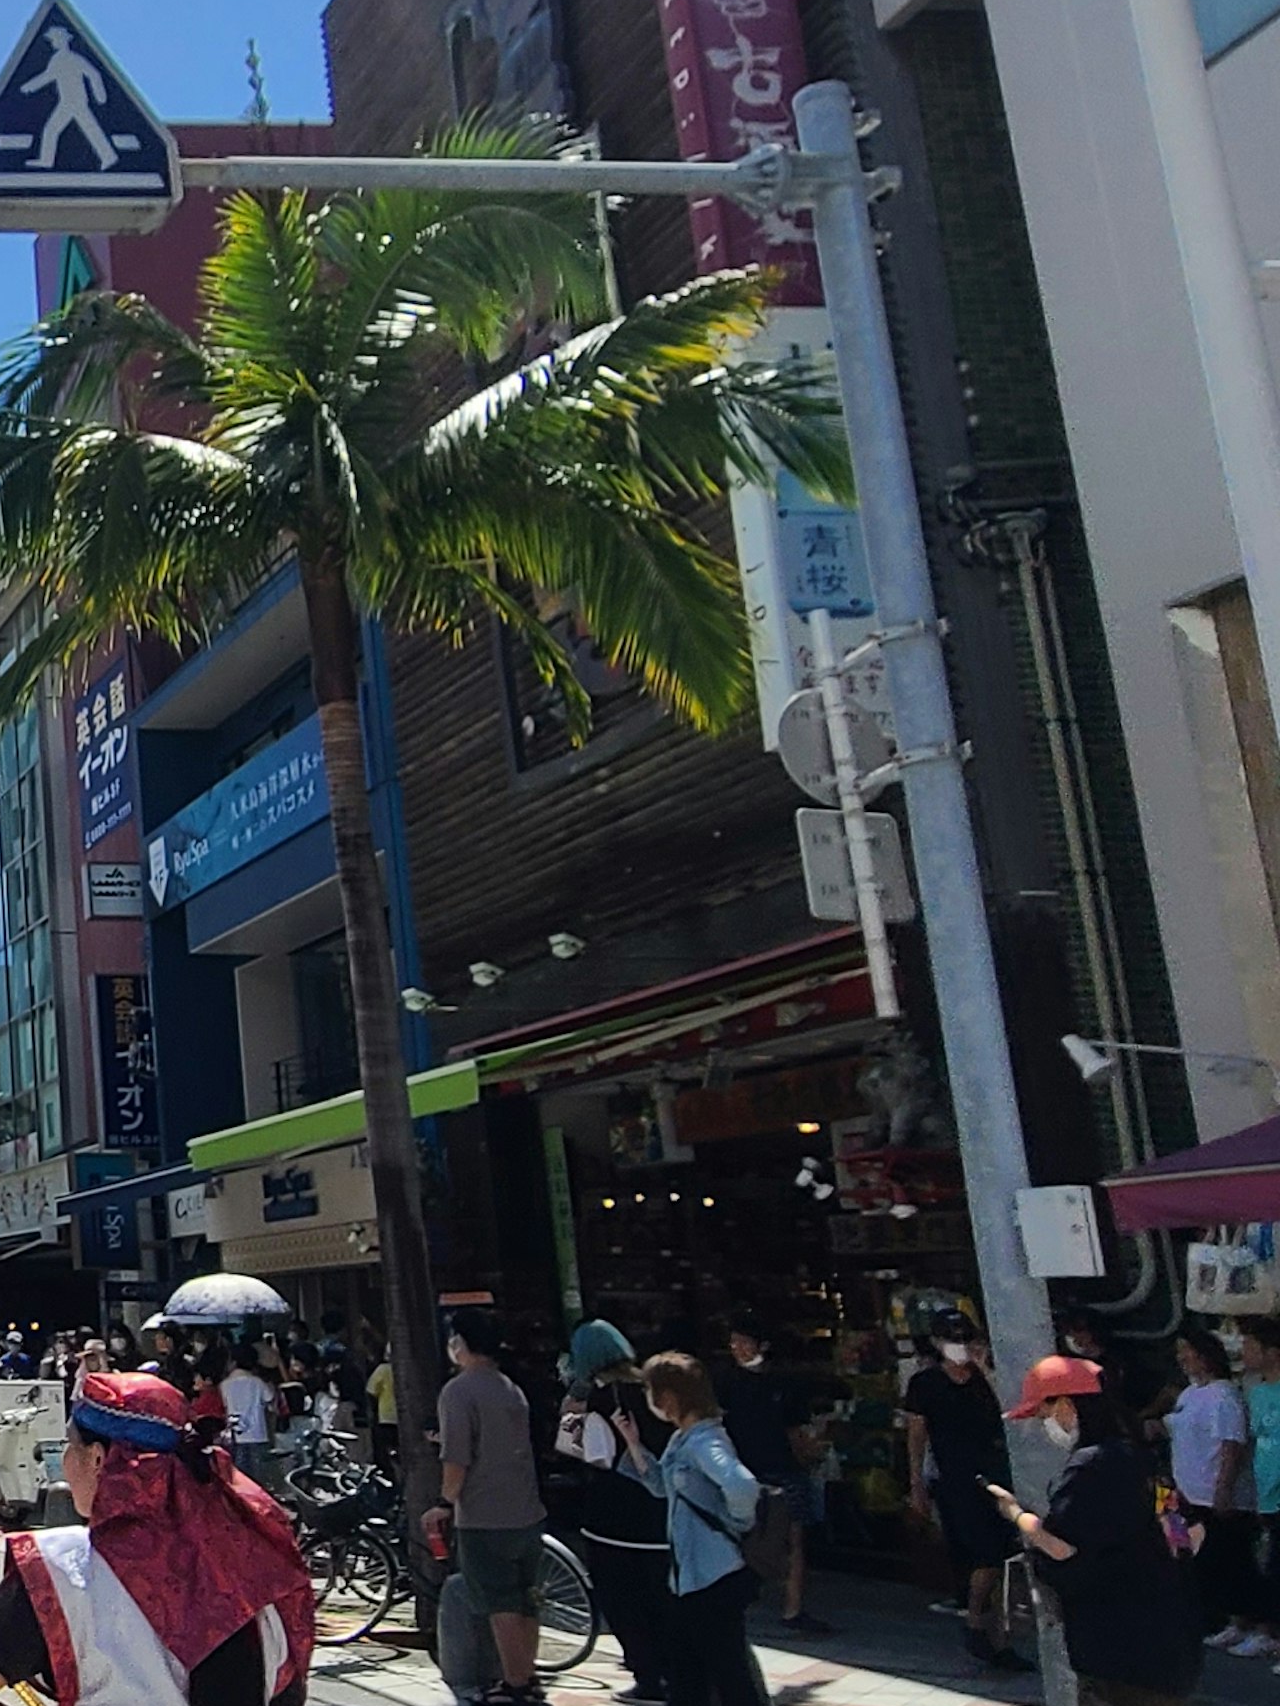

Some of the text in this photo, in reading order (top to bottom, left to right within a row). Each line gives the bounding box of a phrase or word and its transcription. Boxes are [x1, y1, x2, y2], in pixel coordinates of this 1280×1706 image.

[75, 670, 127, 752] 英会話
[78, 724, 129, 791] イーオン
